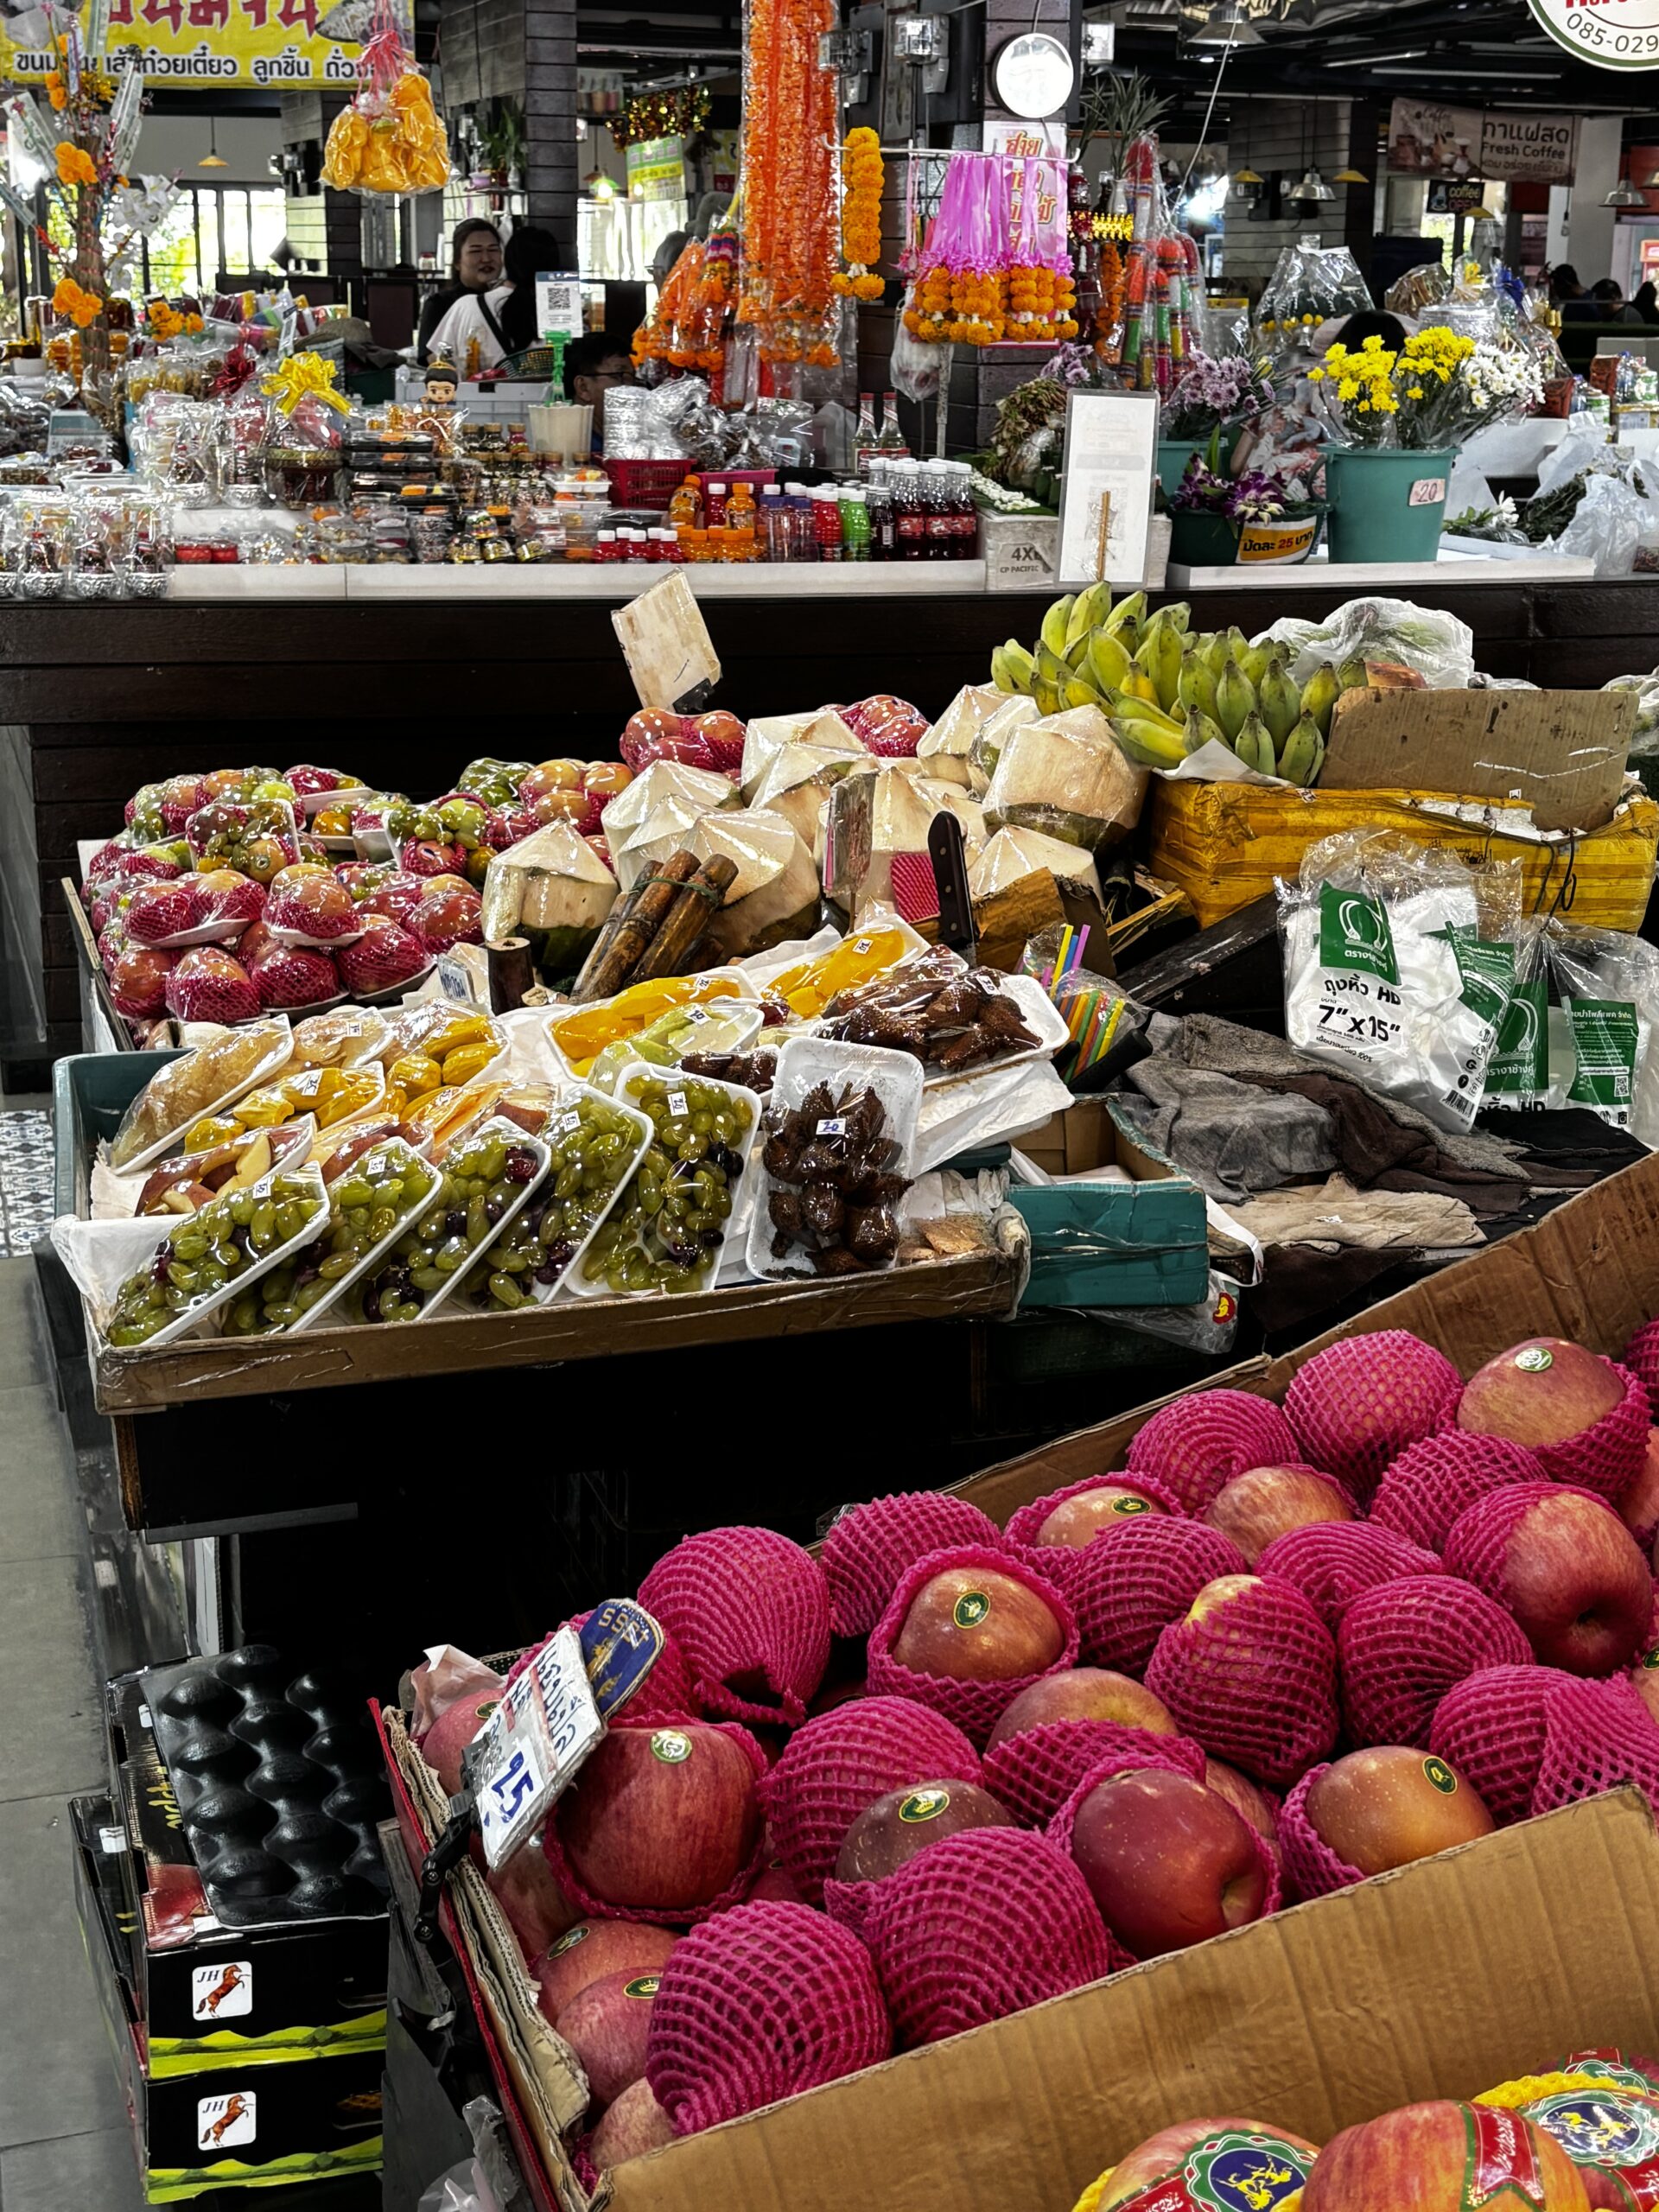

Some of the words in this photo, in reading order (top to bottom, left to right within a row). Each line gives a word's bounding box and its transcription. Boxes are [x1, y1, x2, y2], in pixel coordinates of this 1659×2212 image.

[254, 48, 309, 83] ลูกชิ้น
[1483, 121, 1570, 145] กาแฟสด
[1522, 144, 1567, 160] Coffee
[1277, 537, 1294, 550] 25
[1325, 973, 1369, 996] ถุงหิ้ว
[1377, 986, 1401, 1005] HD
[823, 1121, 840, 1132] 20
[197, 1969, 220, 1983] JH
[202, 2100, 226, 2113] JH
